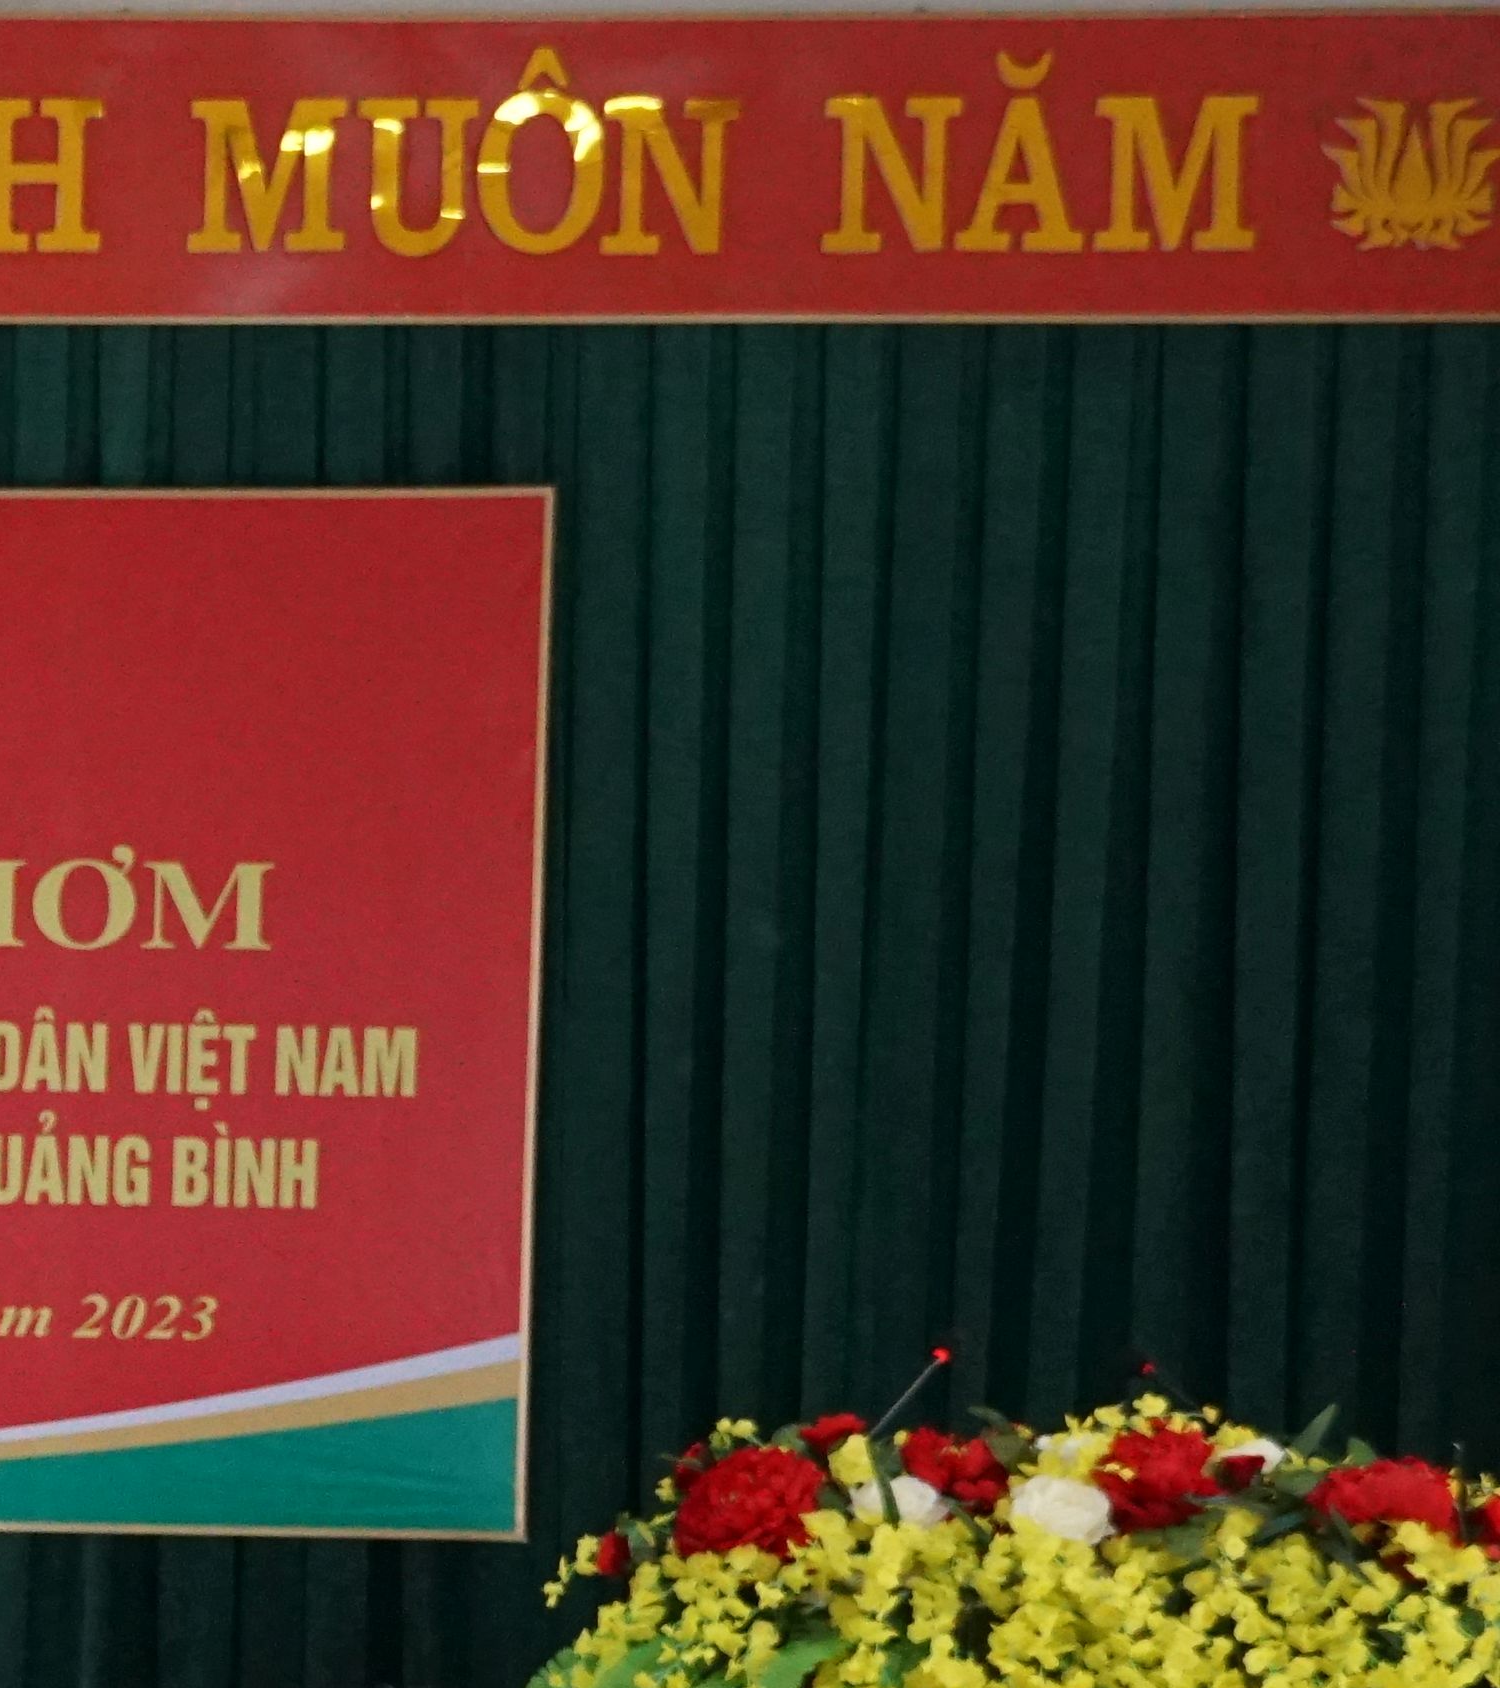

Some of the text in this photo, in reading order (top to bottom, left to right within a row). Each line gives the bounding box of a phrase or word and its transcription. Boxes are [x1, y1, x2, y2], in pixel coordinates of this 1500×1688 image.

[188, 47, 726, 256] MUÔN
[823, 54, 1257, 252] NĂM
[128, 1009, 257, 1110] VIỆT
[275, 1025, 418, 1097] NAM
[172, 1122, 319, 1209] BÌNH
[73, 1294, 217, 1340] 2023
